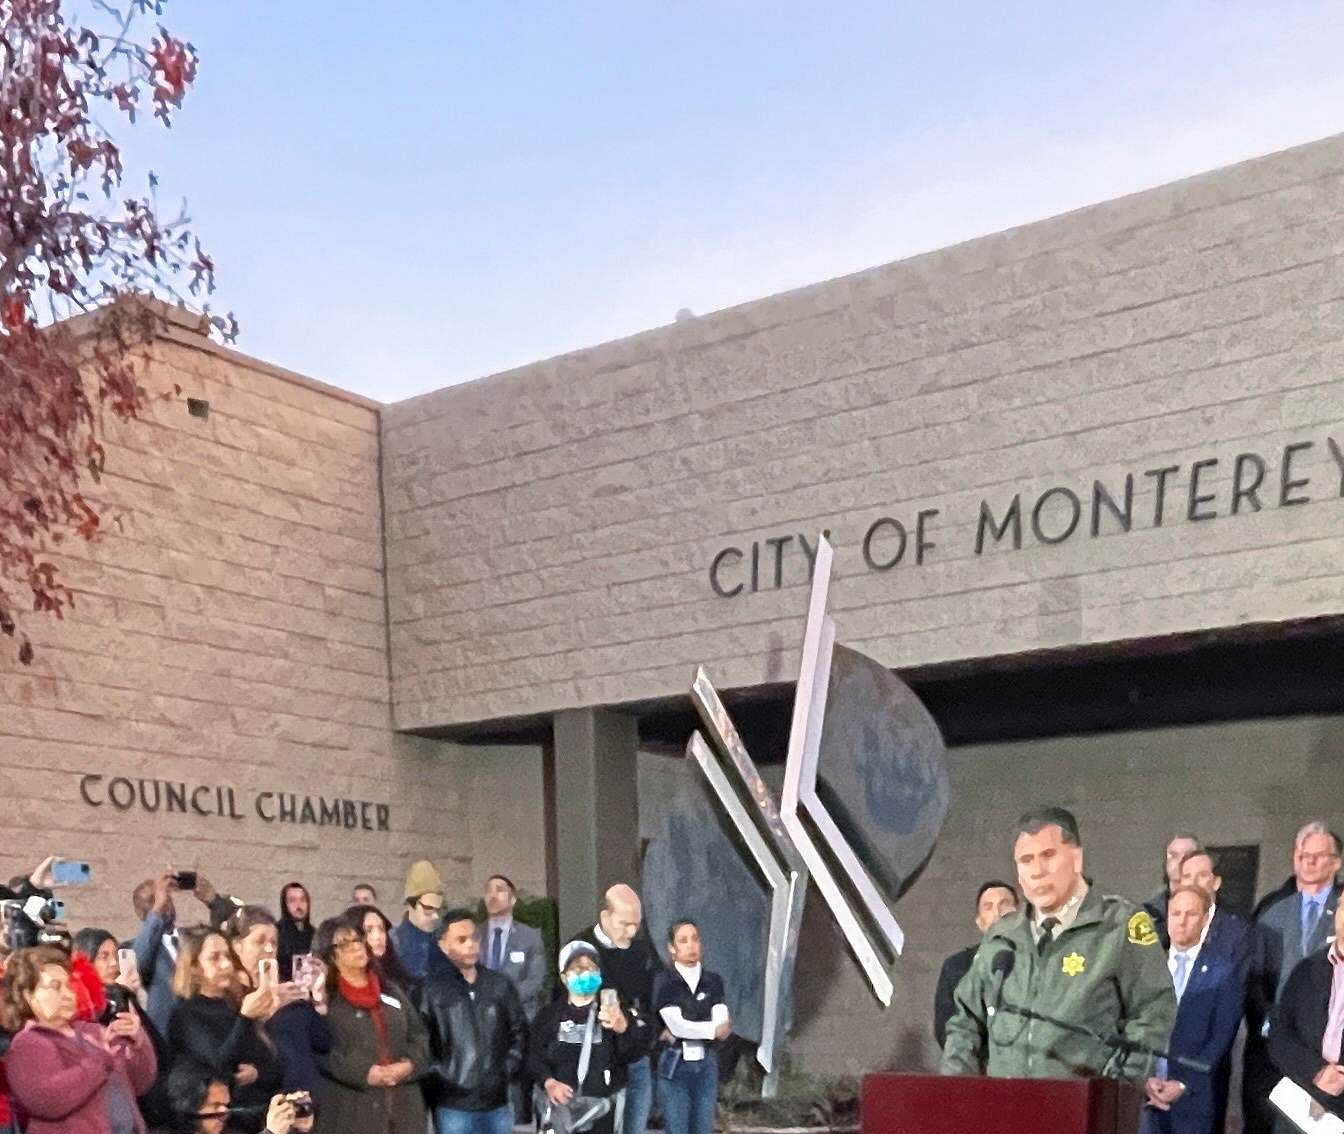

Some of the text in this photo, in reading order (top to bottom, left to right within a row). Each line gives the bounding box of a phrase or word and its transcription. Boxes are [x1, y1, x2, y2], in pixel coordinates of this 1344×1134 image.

[862, 508, 940, 571] OF
[79, 774, 391, 832] COUNCIL CHAMBER
